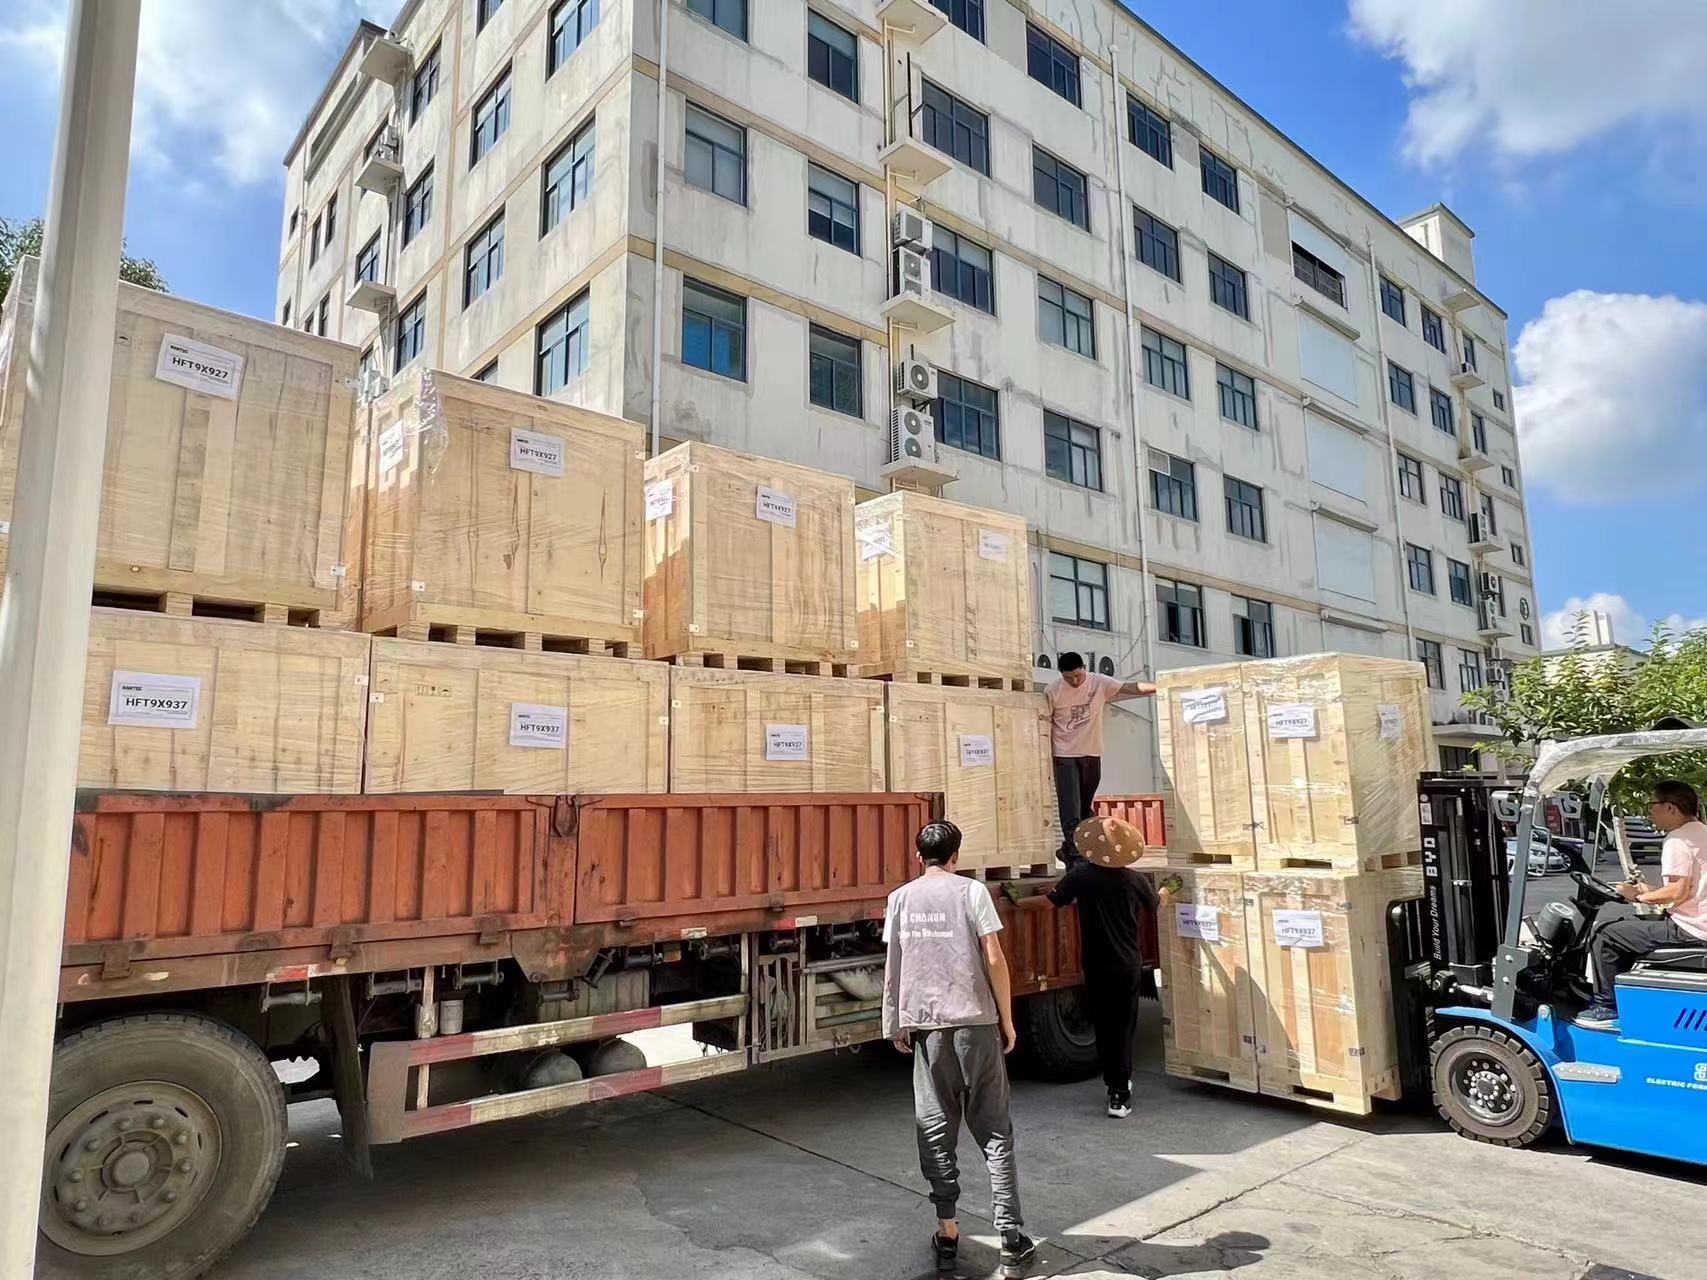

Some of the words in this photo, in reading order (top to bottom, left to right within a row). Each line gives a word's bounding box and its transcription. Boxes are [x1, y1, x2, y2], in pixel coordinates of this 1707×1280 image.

[172, 356, 229, 379] HFT9X927
[519, 447, 558, 461] HFT9X927
[126, 697, 188, 710] HFT9X937
[520, 723, 560, 734] HFT9X937
[1423, 837, 1439, 877] BYD
[1429, 884, 1439, 918] Dreams
[1431, 918, 1440, 937] Your
[1646, 1077, 1686, 1088] ELECTRIC
